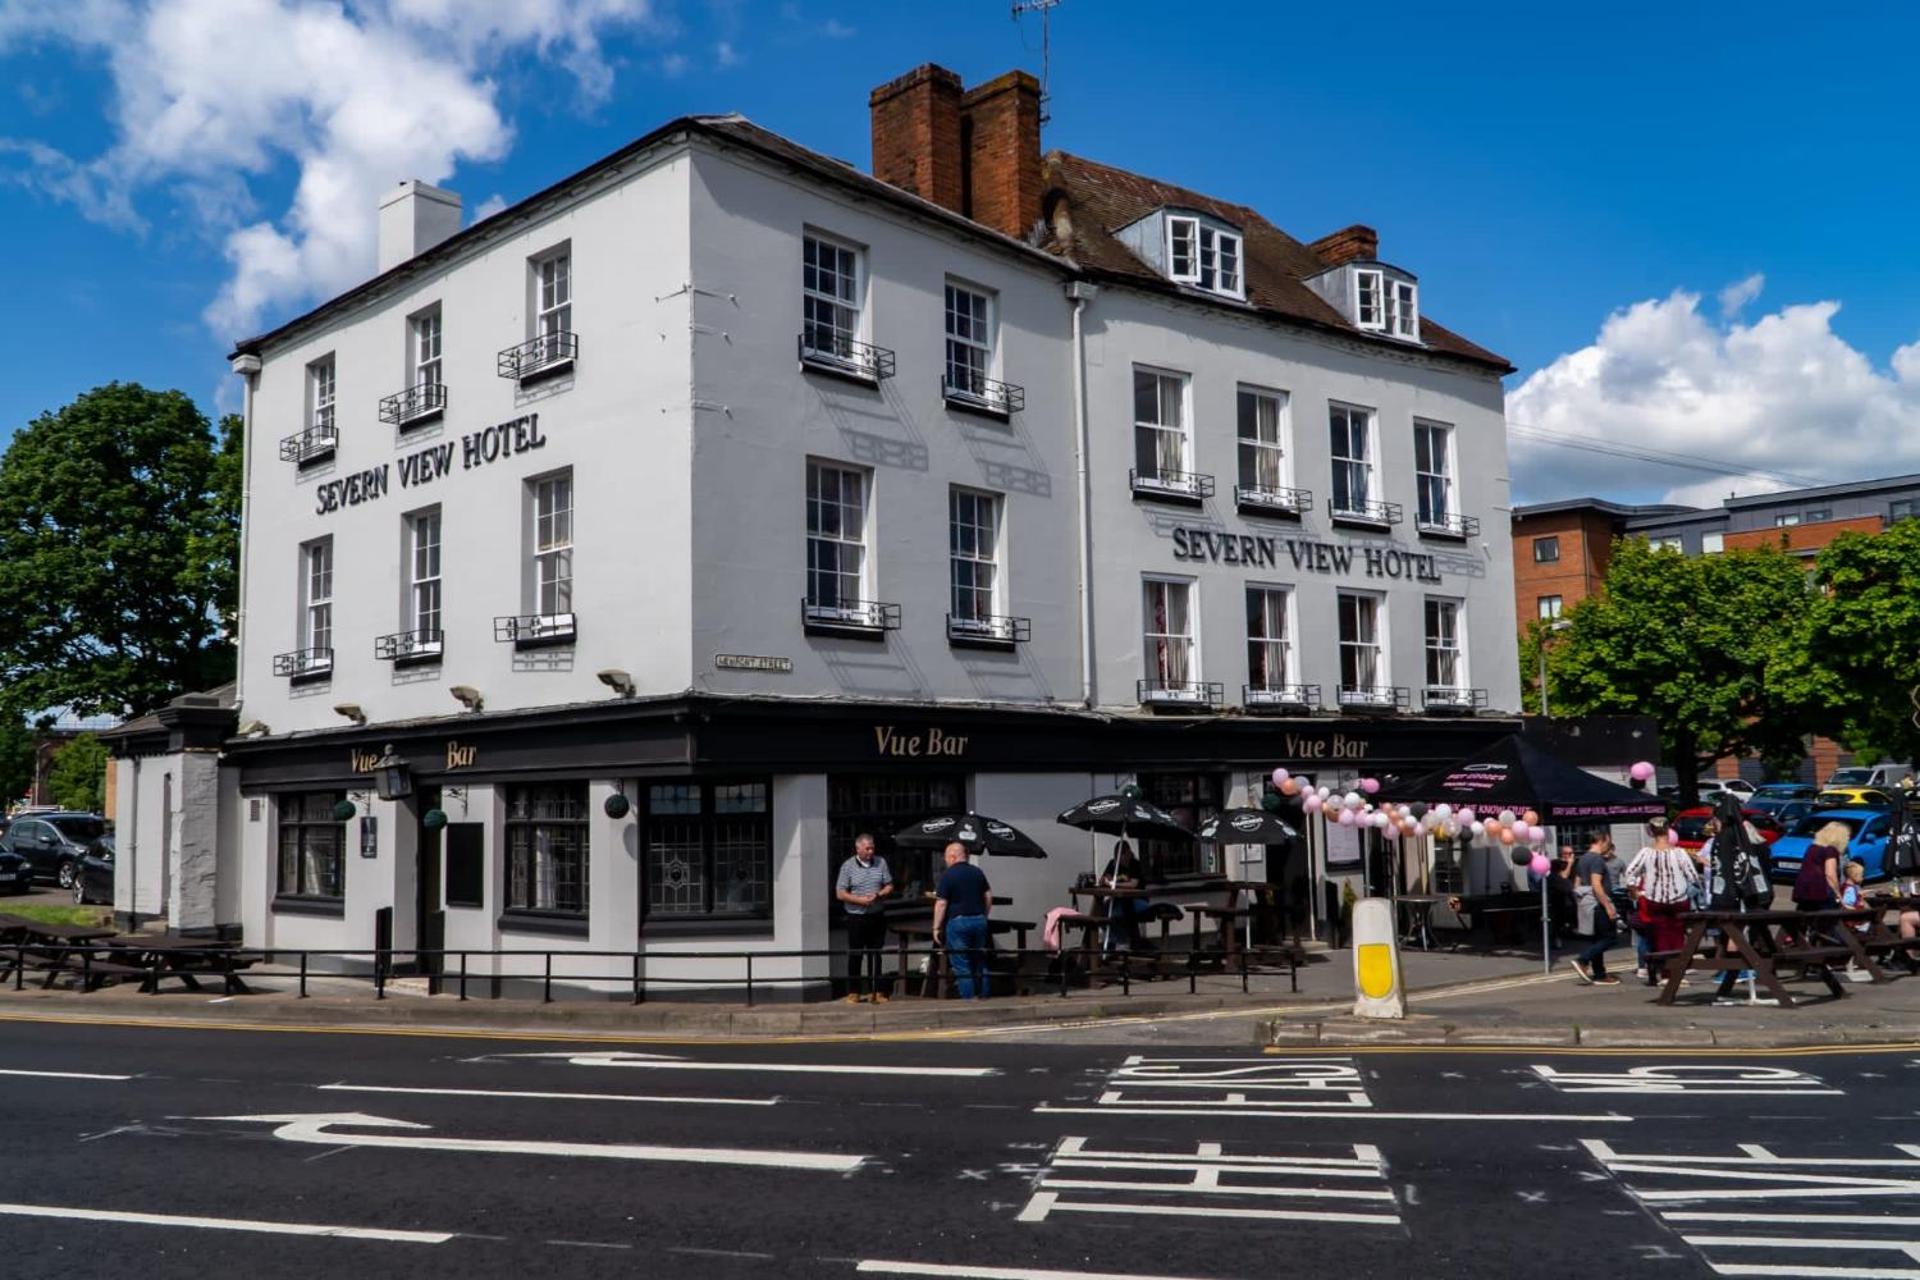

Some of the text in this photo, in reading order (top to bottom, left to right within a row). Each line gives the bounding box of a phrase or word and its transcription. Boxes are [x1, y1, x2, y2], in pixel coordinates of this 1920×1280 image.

[316, 413, 546, 515] SEVERN VIEW HOTEL
[1172, 527, 1442, 583] SEVERN VIEW HOTEL
[351, 741, 477, 773] Vue Bar
[874, 726, 968, 757] Vue Bar
[1285, 733, 1368, 758] Vue Bar
[1016, 1136, 1401, 1224] THE
